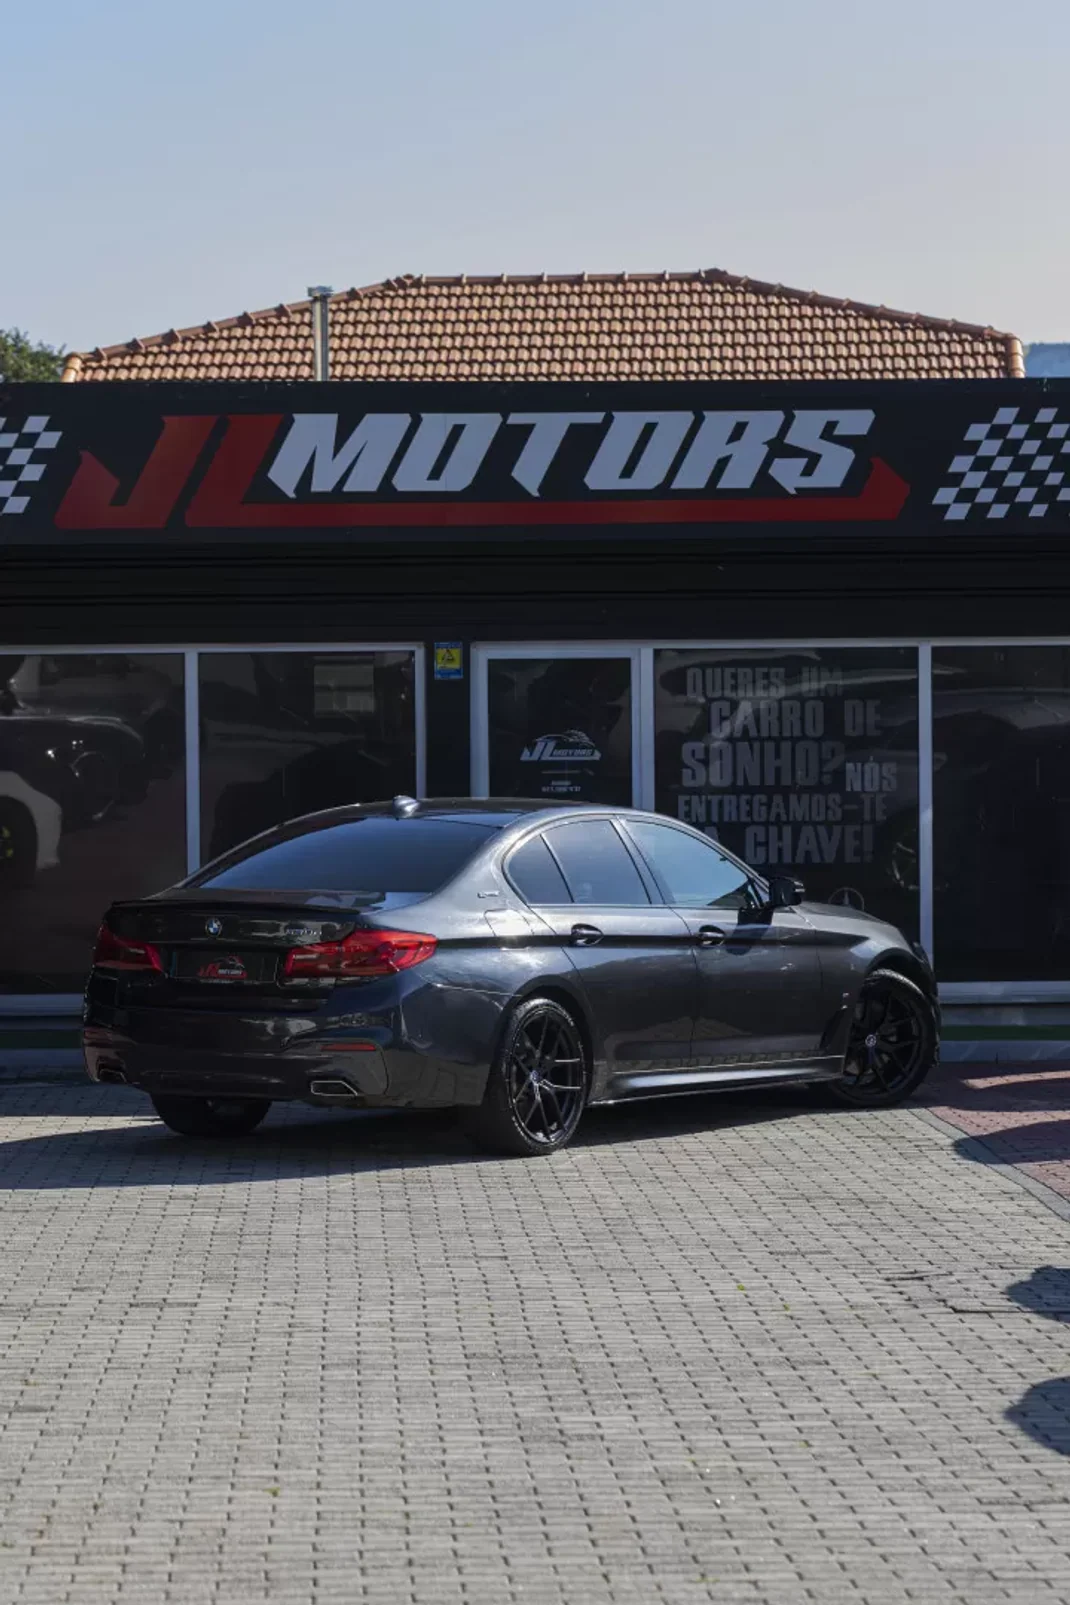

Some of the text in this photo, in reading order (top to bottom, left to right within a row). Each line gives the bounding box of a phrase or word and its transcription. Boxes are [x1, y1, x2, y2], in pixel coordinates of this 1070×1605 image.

[686, 667, 785, 698] QUERES
[710, 700, 882, 738] CARRO DE
[681, 740, 898, 792] SONHO? NÓS
[677, 794, 887, 823] ENTREGAMOS-TE
[745, 825, 876, 865] CHAVE!
